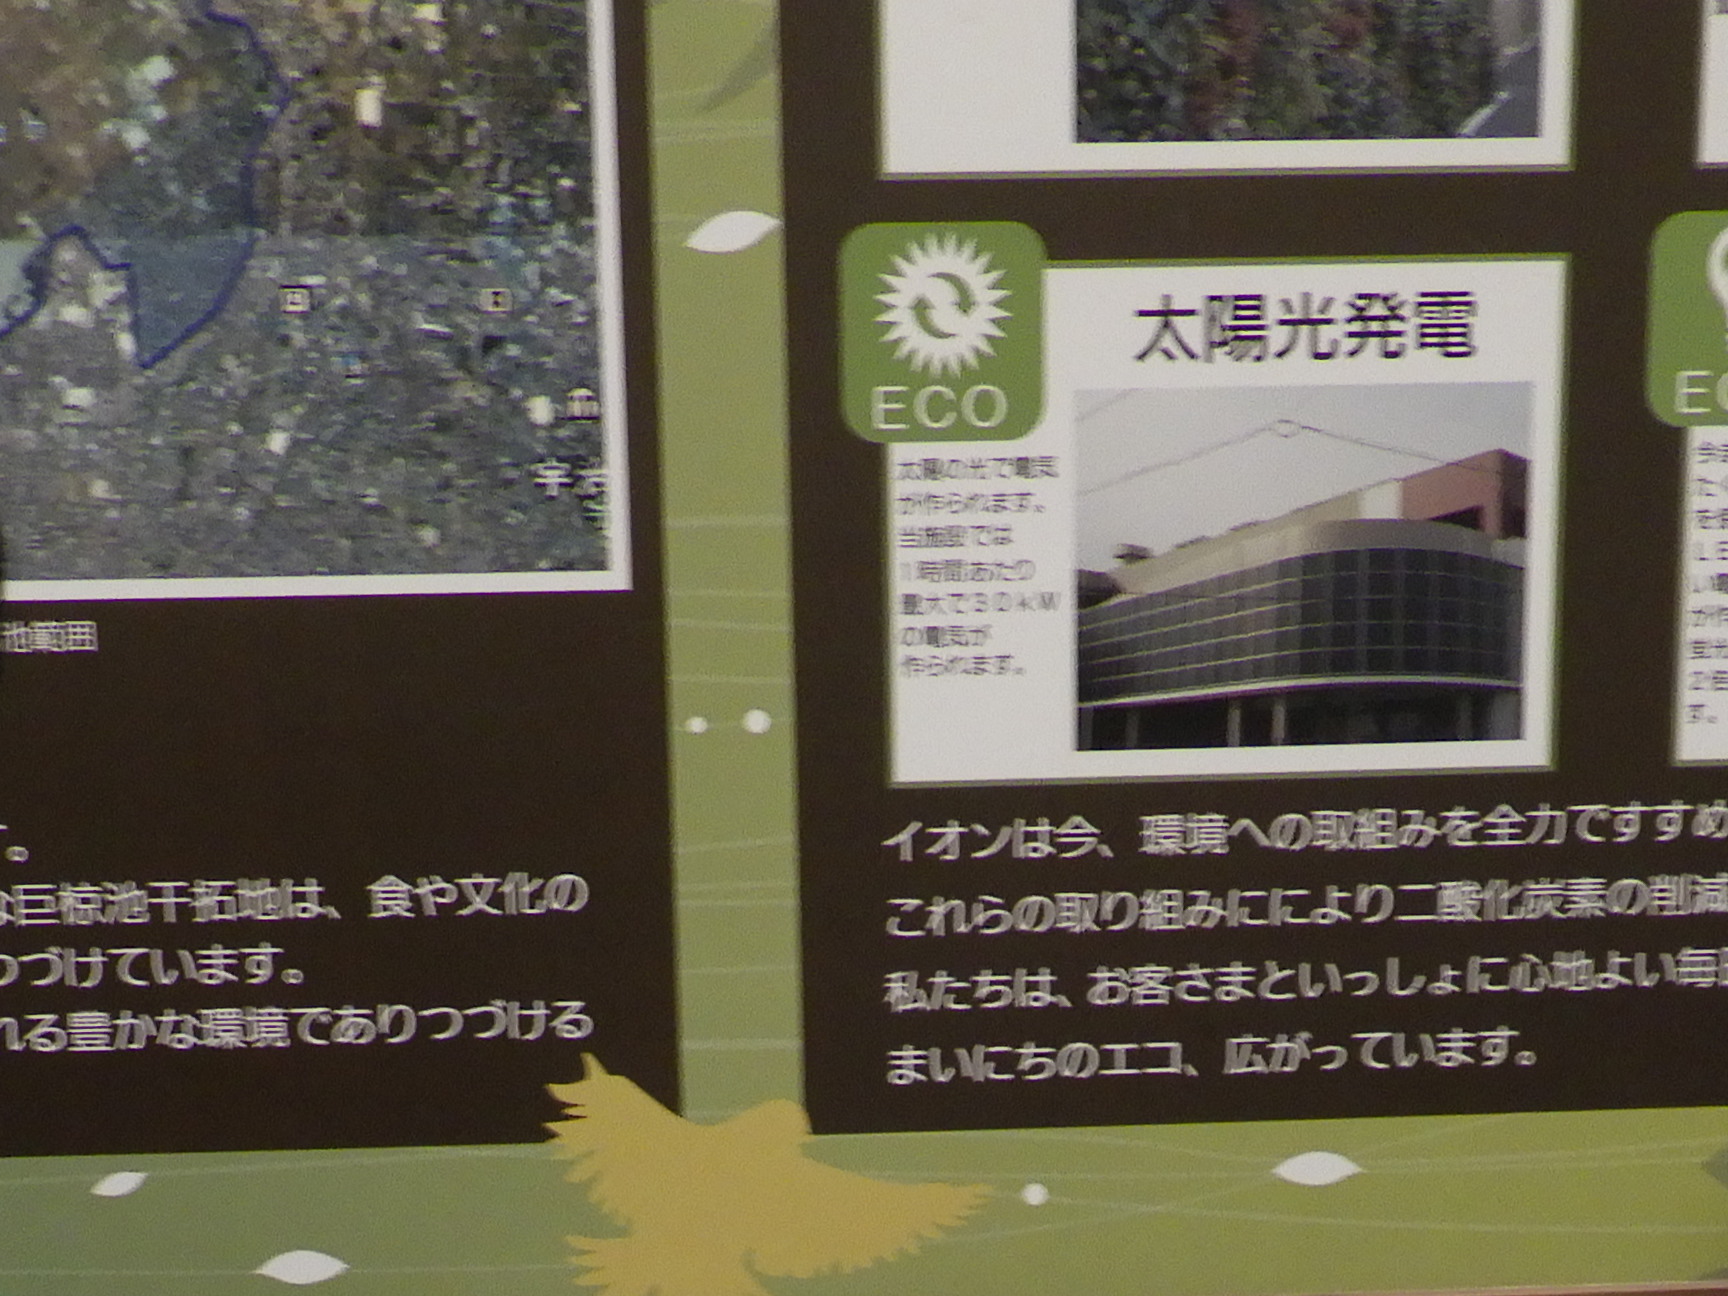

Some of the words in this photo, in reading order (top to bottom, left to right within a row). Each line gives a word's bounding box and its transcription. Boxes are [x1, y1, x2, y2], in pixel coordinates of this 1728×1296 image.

[1133, 291, 1478, 362] 太陽光発電
[871, 385, 1008, 429] ECO
[895, 456, 1059, 480] 太陽の光で電気
[886, 1027, 1537, 1085] まいにちのエコ、広がっています。
